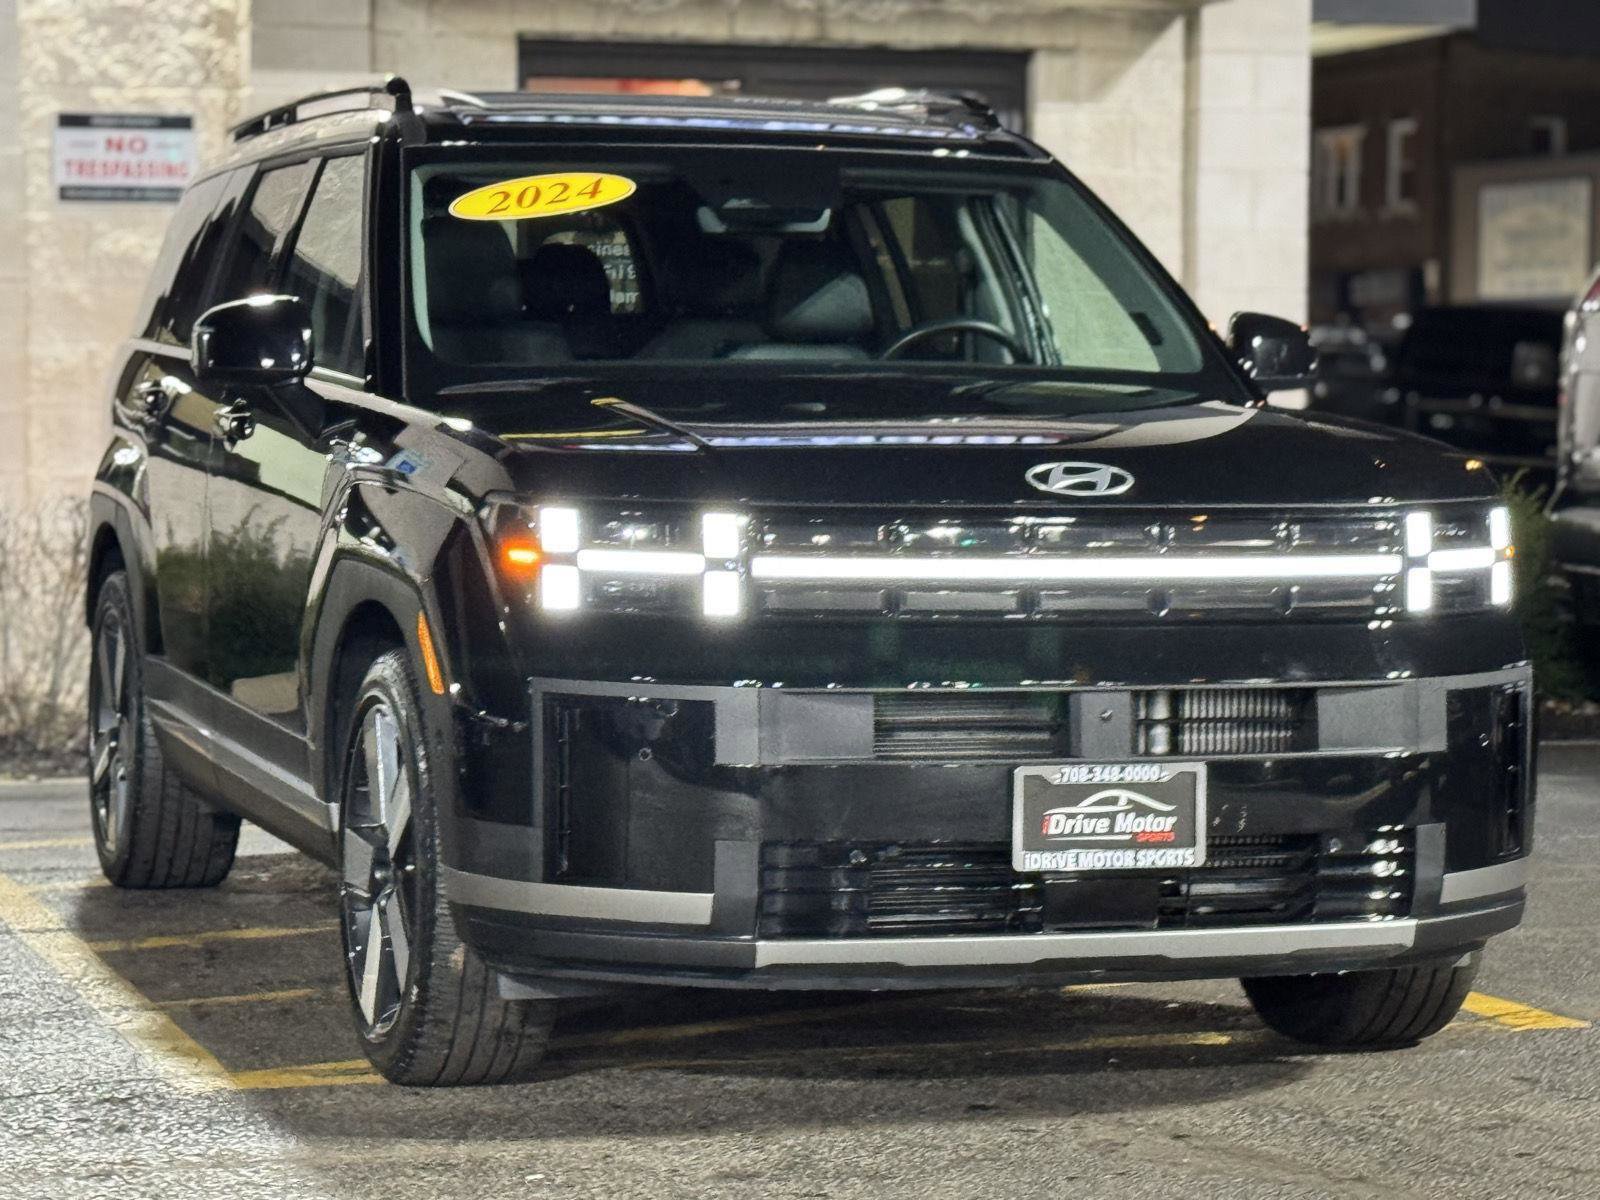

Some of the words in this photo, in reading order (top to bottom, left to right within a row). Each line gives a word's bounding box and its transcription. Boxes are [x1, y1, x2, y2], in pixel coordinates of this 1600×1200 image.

[105, 137, 147, 154] NO
[487, 177, 603, 214] 2024
[1041, 813, 1112, 836] iDrive
[1114, 811, 1178, 834] Motor
[1078, 850, 1136, 869] MOTOR
[1136, 848, 1195, 868] SPORTS
